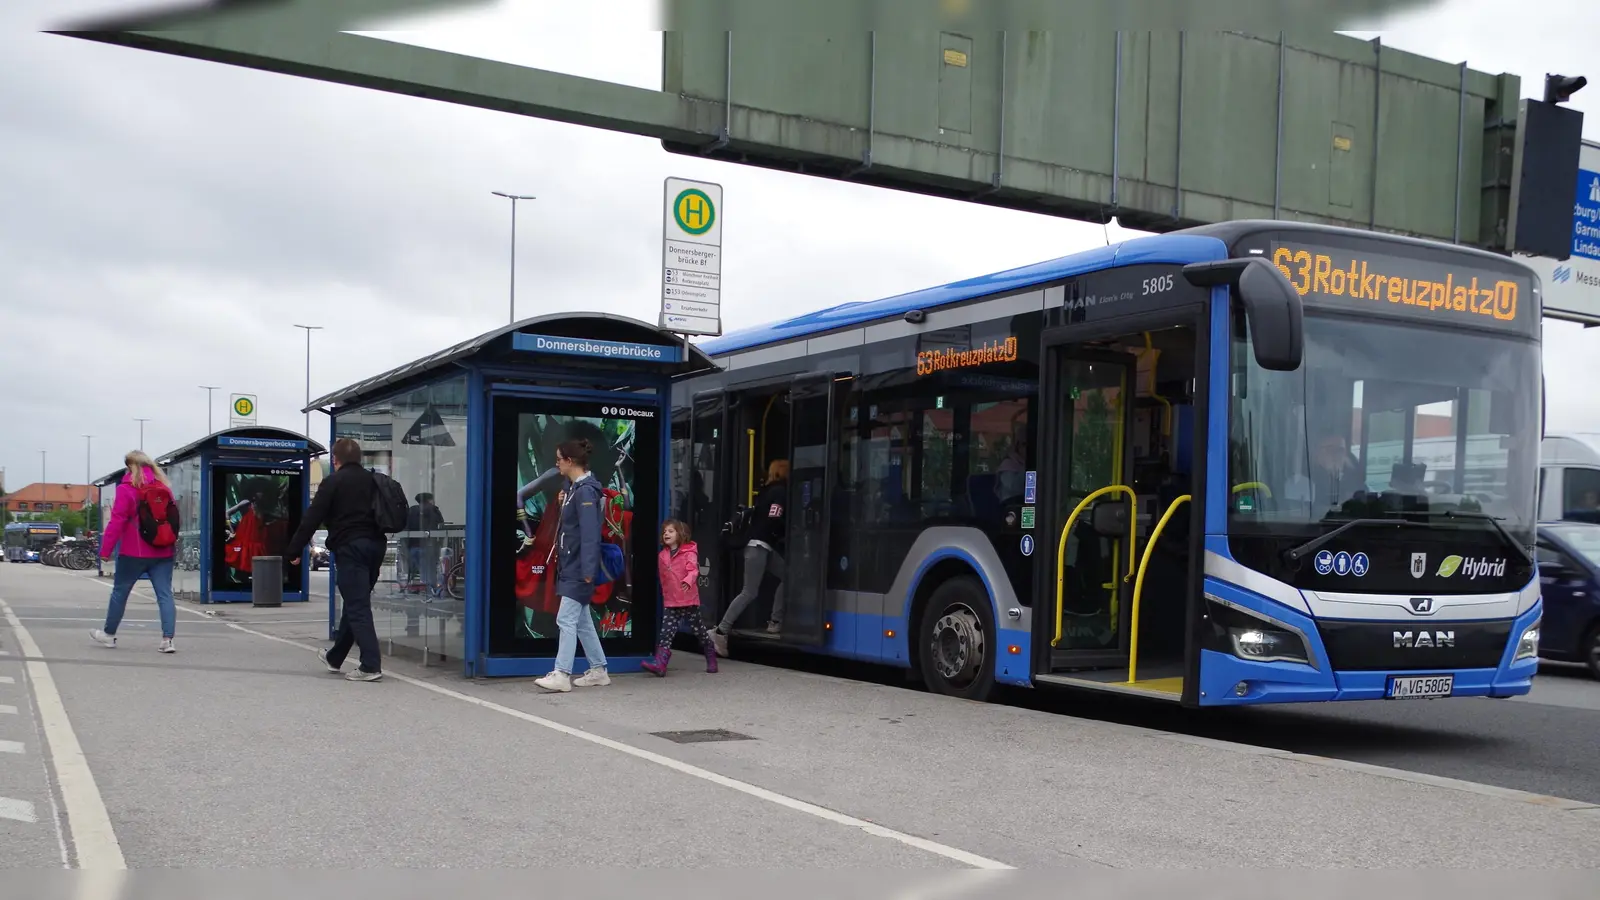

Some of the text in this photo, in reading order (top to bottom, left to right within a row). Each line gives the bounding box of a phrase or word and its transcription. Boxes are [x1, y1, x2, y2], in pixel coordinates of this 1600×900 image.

[686, 198, 703, 226] H
[669, 245, 717, 259] Donnersberger-
[677, 256, 699, 266] brücke
[1142, 274, 1174, 296] 5805
[1273, 247, 1312, 296] 63
[1313, 254, 1495, 316] Rotkreuzplatz
[1064, 294, 1096, 311] MAN
[536, 337, 661, 359] Donnersbergerbrücke
[917, 349, 933, 376] 63
[933, 340, 1005, 371] Rotkreuzplatz
[240, 401, 248, 413] H
[627, 408, 654, 418] Decaux
[229, 438, 296, 448] Donnersbergerbrücke
[1462, 556, 1507, 580] Hybrid
[1393, 631, 1455, 648] MAN
